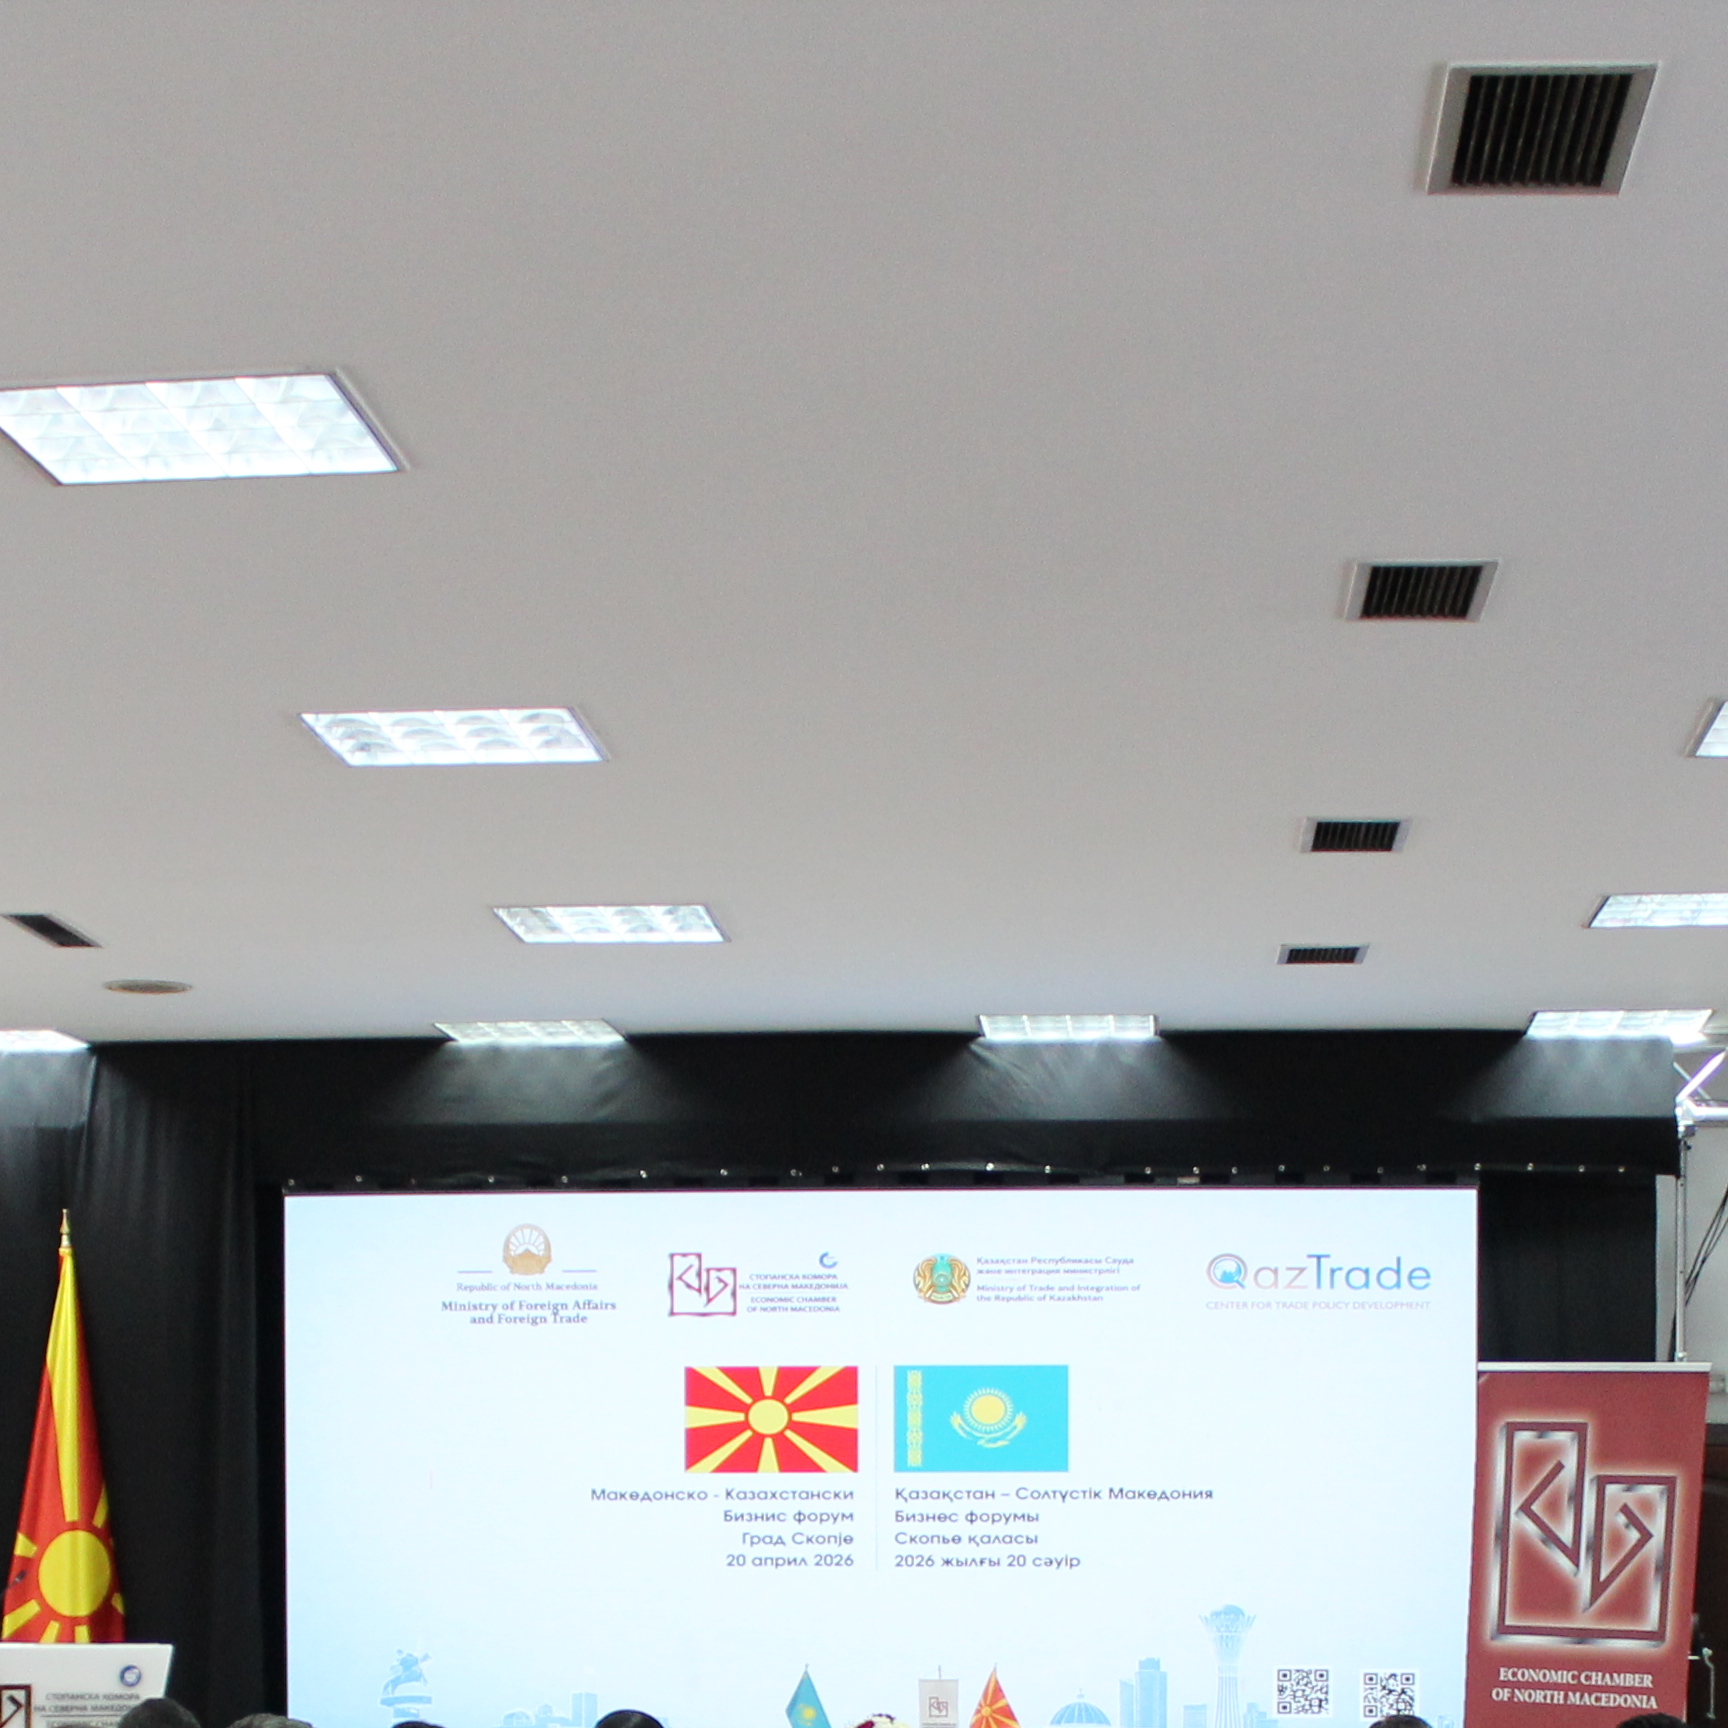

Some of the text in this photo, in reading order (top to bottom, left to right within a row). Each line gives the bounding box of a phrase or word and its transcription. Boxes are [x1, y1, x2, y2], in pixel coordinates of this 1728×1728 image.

[1206, 1253, 1431, 1290] QazTrade
[456, 1281, 598, 1293] Republic of North Macedonia
[977, 1284, 1014, 1294] Ministry
[1017, 1284, 1027, 1292] of
[1029, 1284, 1055, 1292] Trade
[1077, 1284, 1128, 1294] Integration
[1049, 1294, 1103, 1302] Kazakhstan
[1206, 1301, 1431, 1310] CENTER FOR TRADE POLICY DEVELOPMENT
[441, 1299, 617, 1316] Ministry of Foreign Affairs
[746, 1305, 841, 1313] OF NORTH MACEDONIA
[470, 1312, 588, 1327] and Foreign Trade
[591, 1488, 708, 1502] Македонско
[725, 1488, 854, 1500] Казахстански
[894, 1487, 995, 1503] Қазақстан
[1016, 1487, 1102, 1503] Солтүстік
[1108, 1487, 1213, 1501] Македония
[723, 1510, 854, 1524] Бизнис форум
[894, 1510, 1039, 1525] Бизнес форумы
[742, 1532, 854, 1547] Град Скопје
[894, 1532, 1038, 1547] Скопье қаласы
[726, 1554, 854, 1569] 20 април 2026
[894, 1554, 1080, 1569] 2026 жылғы 20 сәуір
[1499, 1667, 1653, 1688] ECONOMIC CHAMBER
[1492, 1687, 1658, 1709] OF NORTH MACEDONIA
